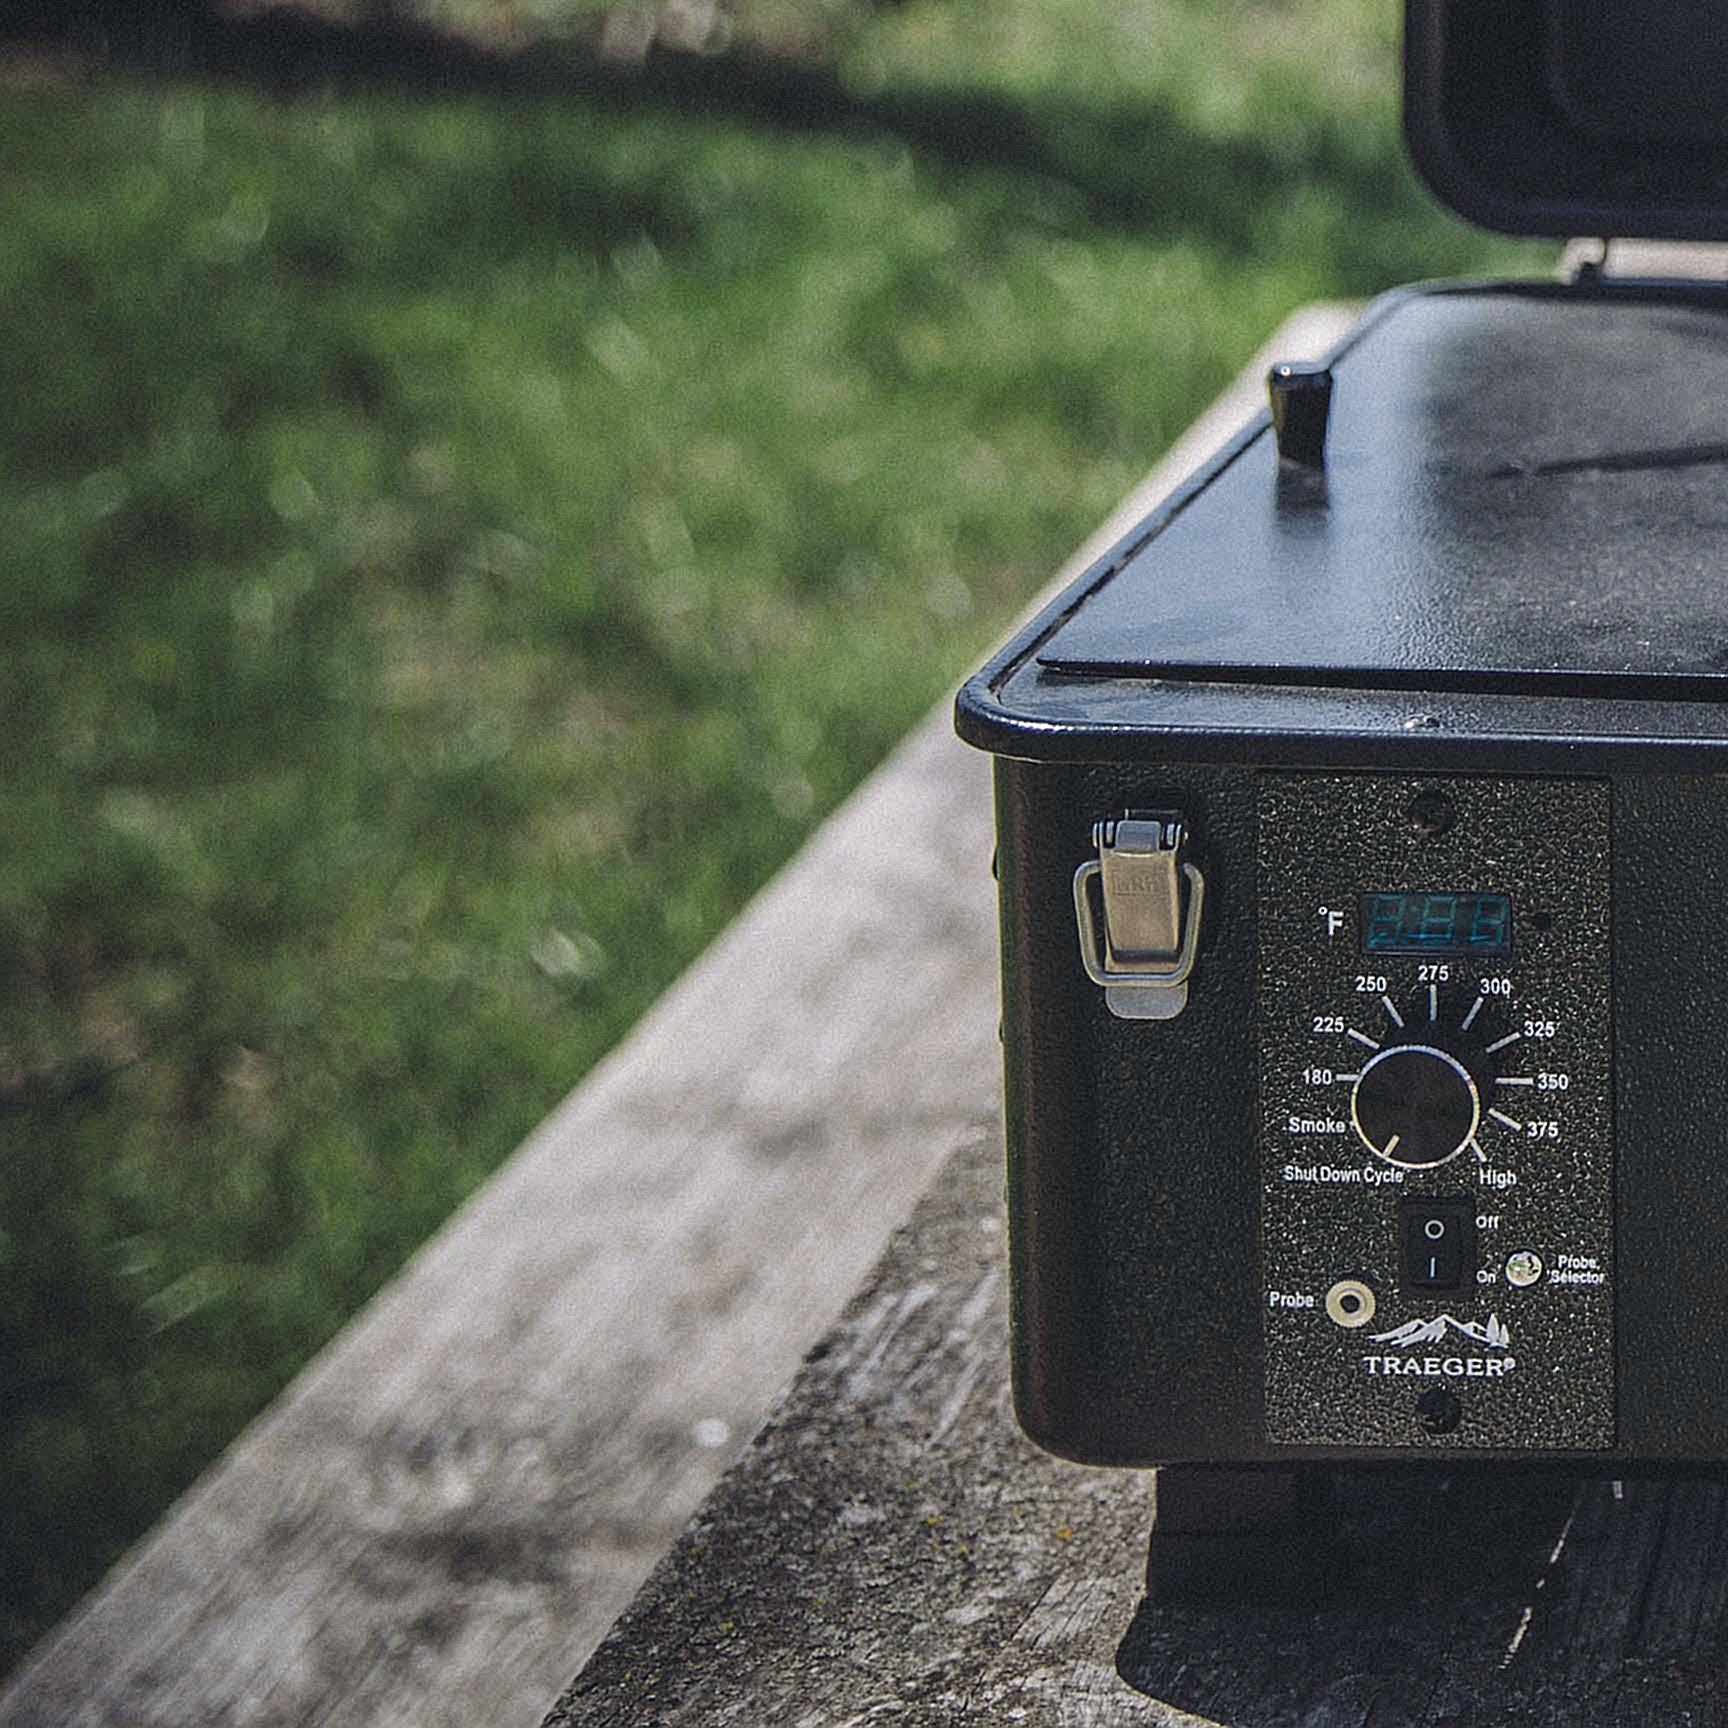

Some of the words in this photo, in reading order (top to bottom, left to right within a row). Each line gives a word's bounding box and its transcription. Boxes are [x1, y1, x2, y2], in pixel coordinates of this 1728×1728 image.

[1417, 965, 1449, 982] 275
[1355, 975, 1388, 993] 250
[1480, 978, 1511, 995] 300
[1312, 1017, 1345, 1034] 225
[1523, 1020, 1556, 1038] 325
[1302, 1069, 1333, 1086] 180
[1537, 1073, 1569, 1090] 350
[1288, 1117, 1346, 1134] Smoke
[1527, 1120, 1559, 1138] 375
[1284, 1165, 1318, 1183] Shut
[1320, 1166, 1361, 1183] Down
[1363, 1166, 1405, 1187] Cycle
[1478, 1168, 1517, 1189] High
[1475, 1214, 1499, 1229] Off
[1557, 1254, 1597, 1269] Probe
[1475, 1269, 1497, 1284] On
[1551, 1269, 1604, 1285] Selector
[1269, 1290, 1315, 1308] Probe
